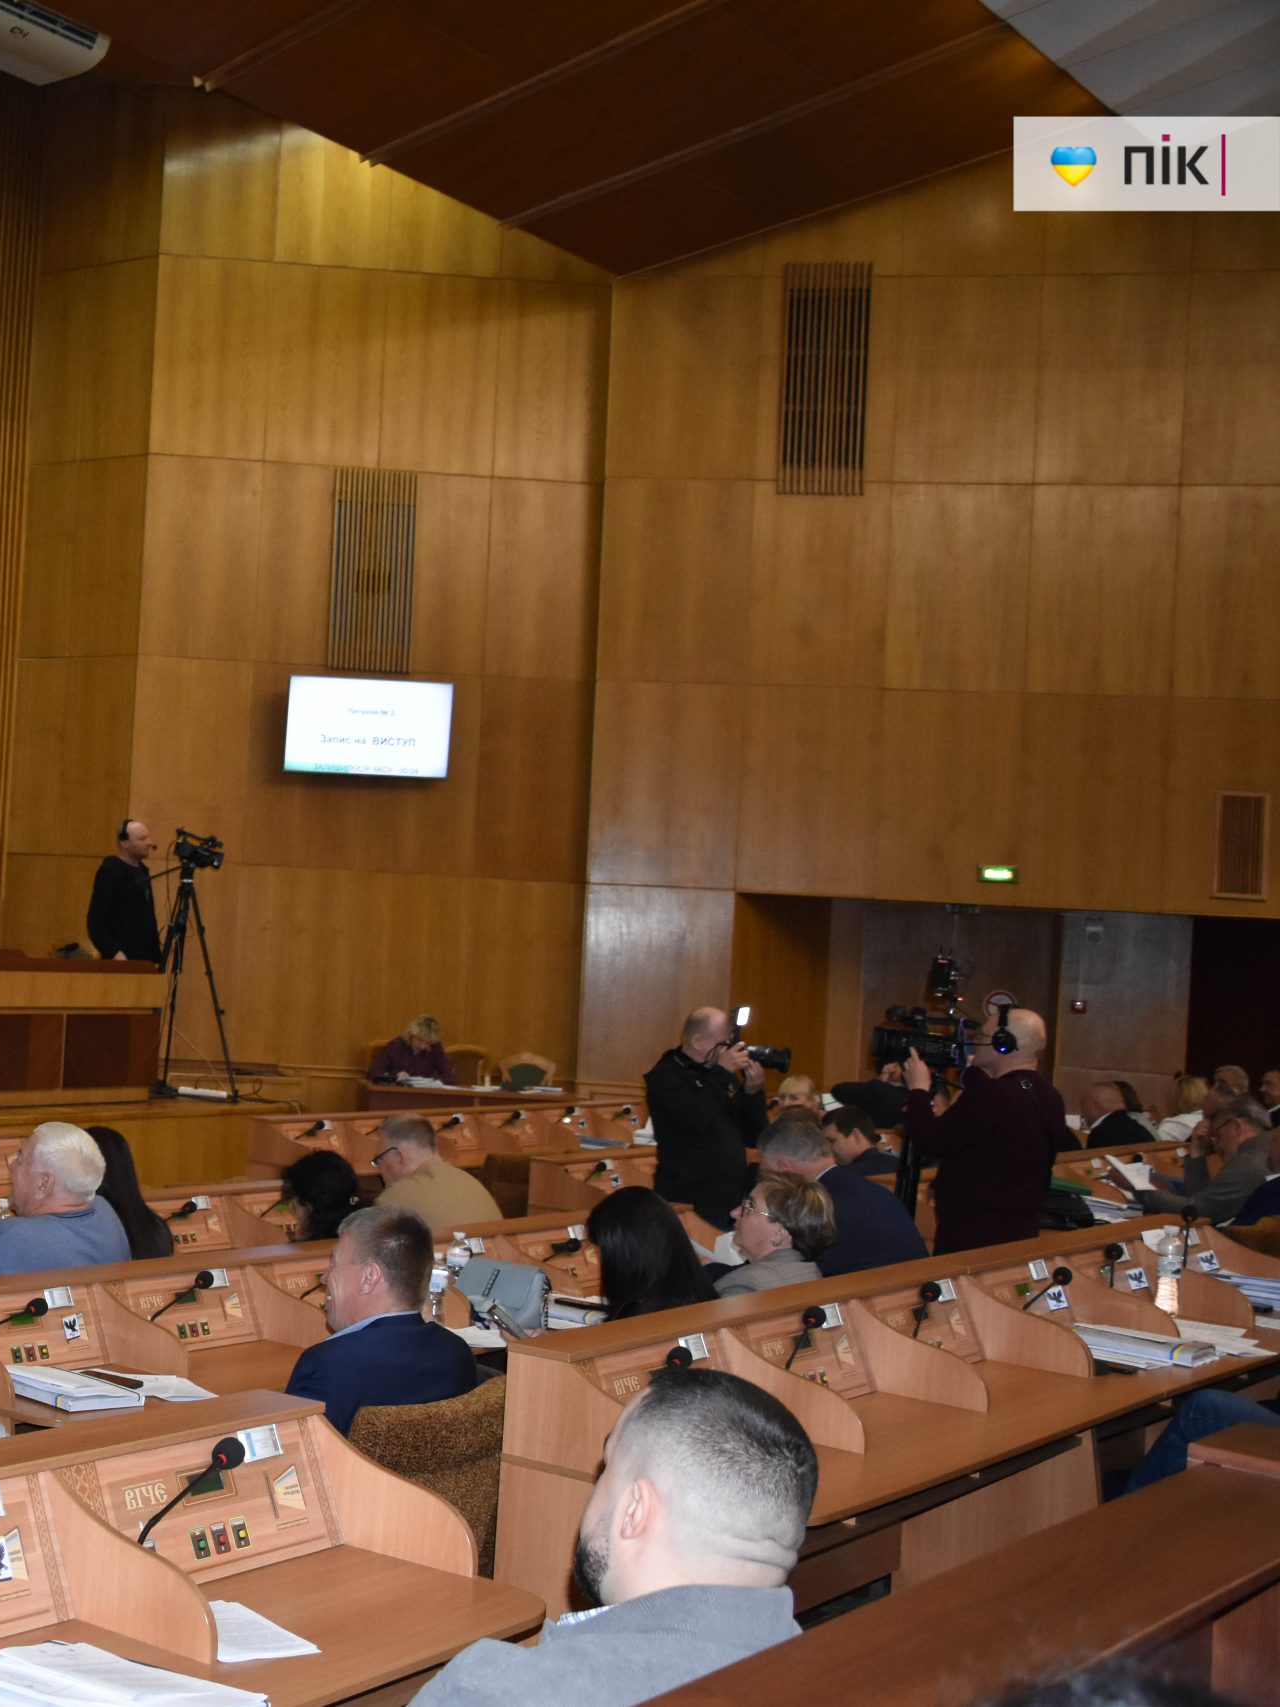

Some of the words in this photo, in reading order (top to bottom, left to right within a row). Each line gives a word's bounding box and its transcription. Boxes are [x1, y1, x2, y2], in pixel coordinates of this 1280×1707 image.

[321, 734, 351, 745] Запис
[354, 737, 366, 745] на
[372, 737, 416, 747] ВИСТУП
